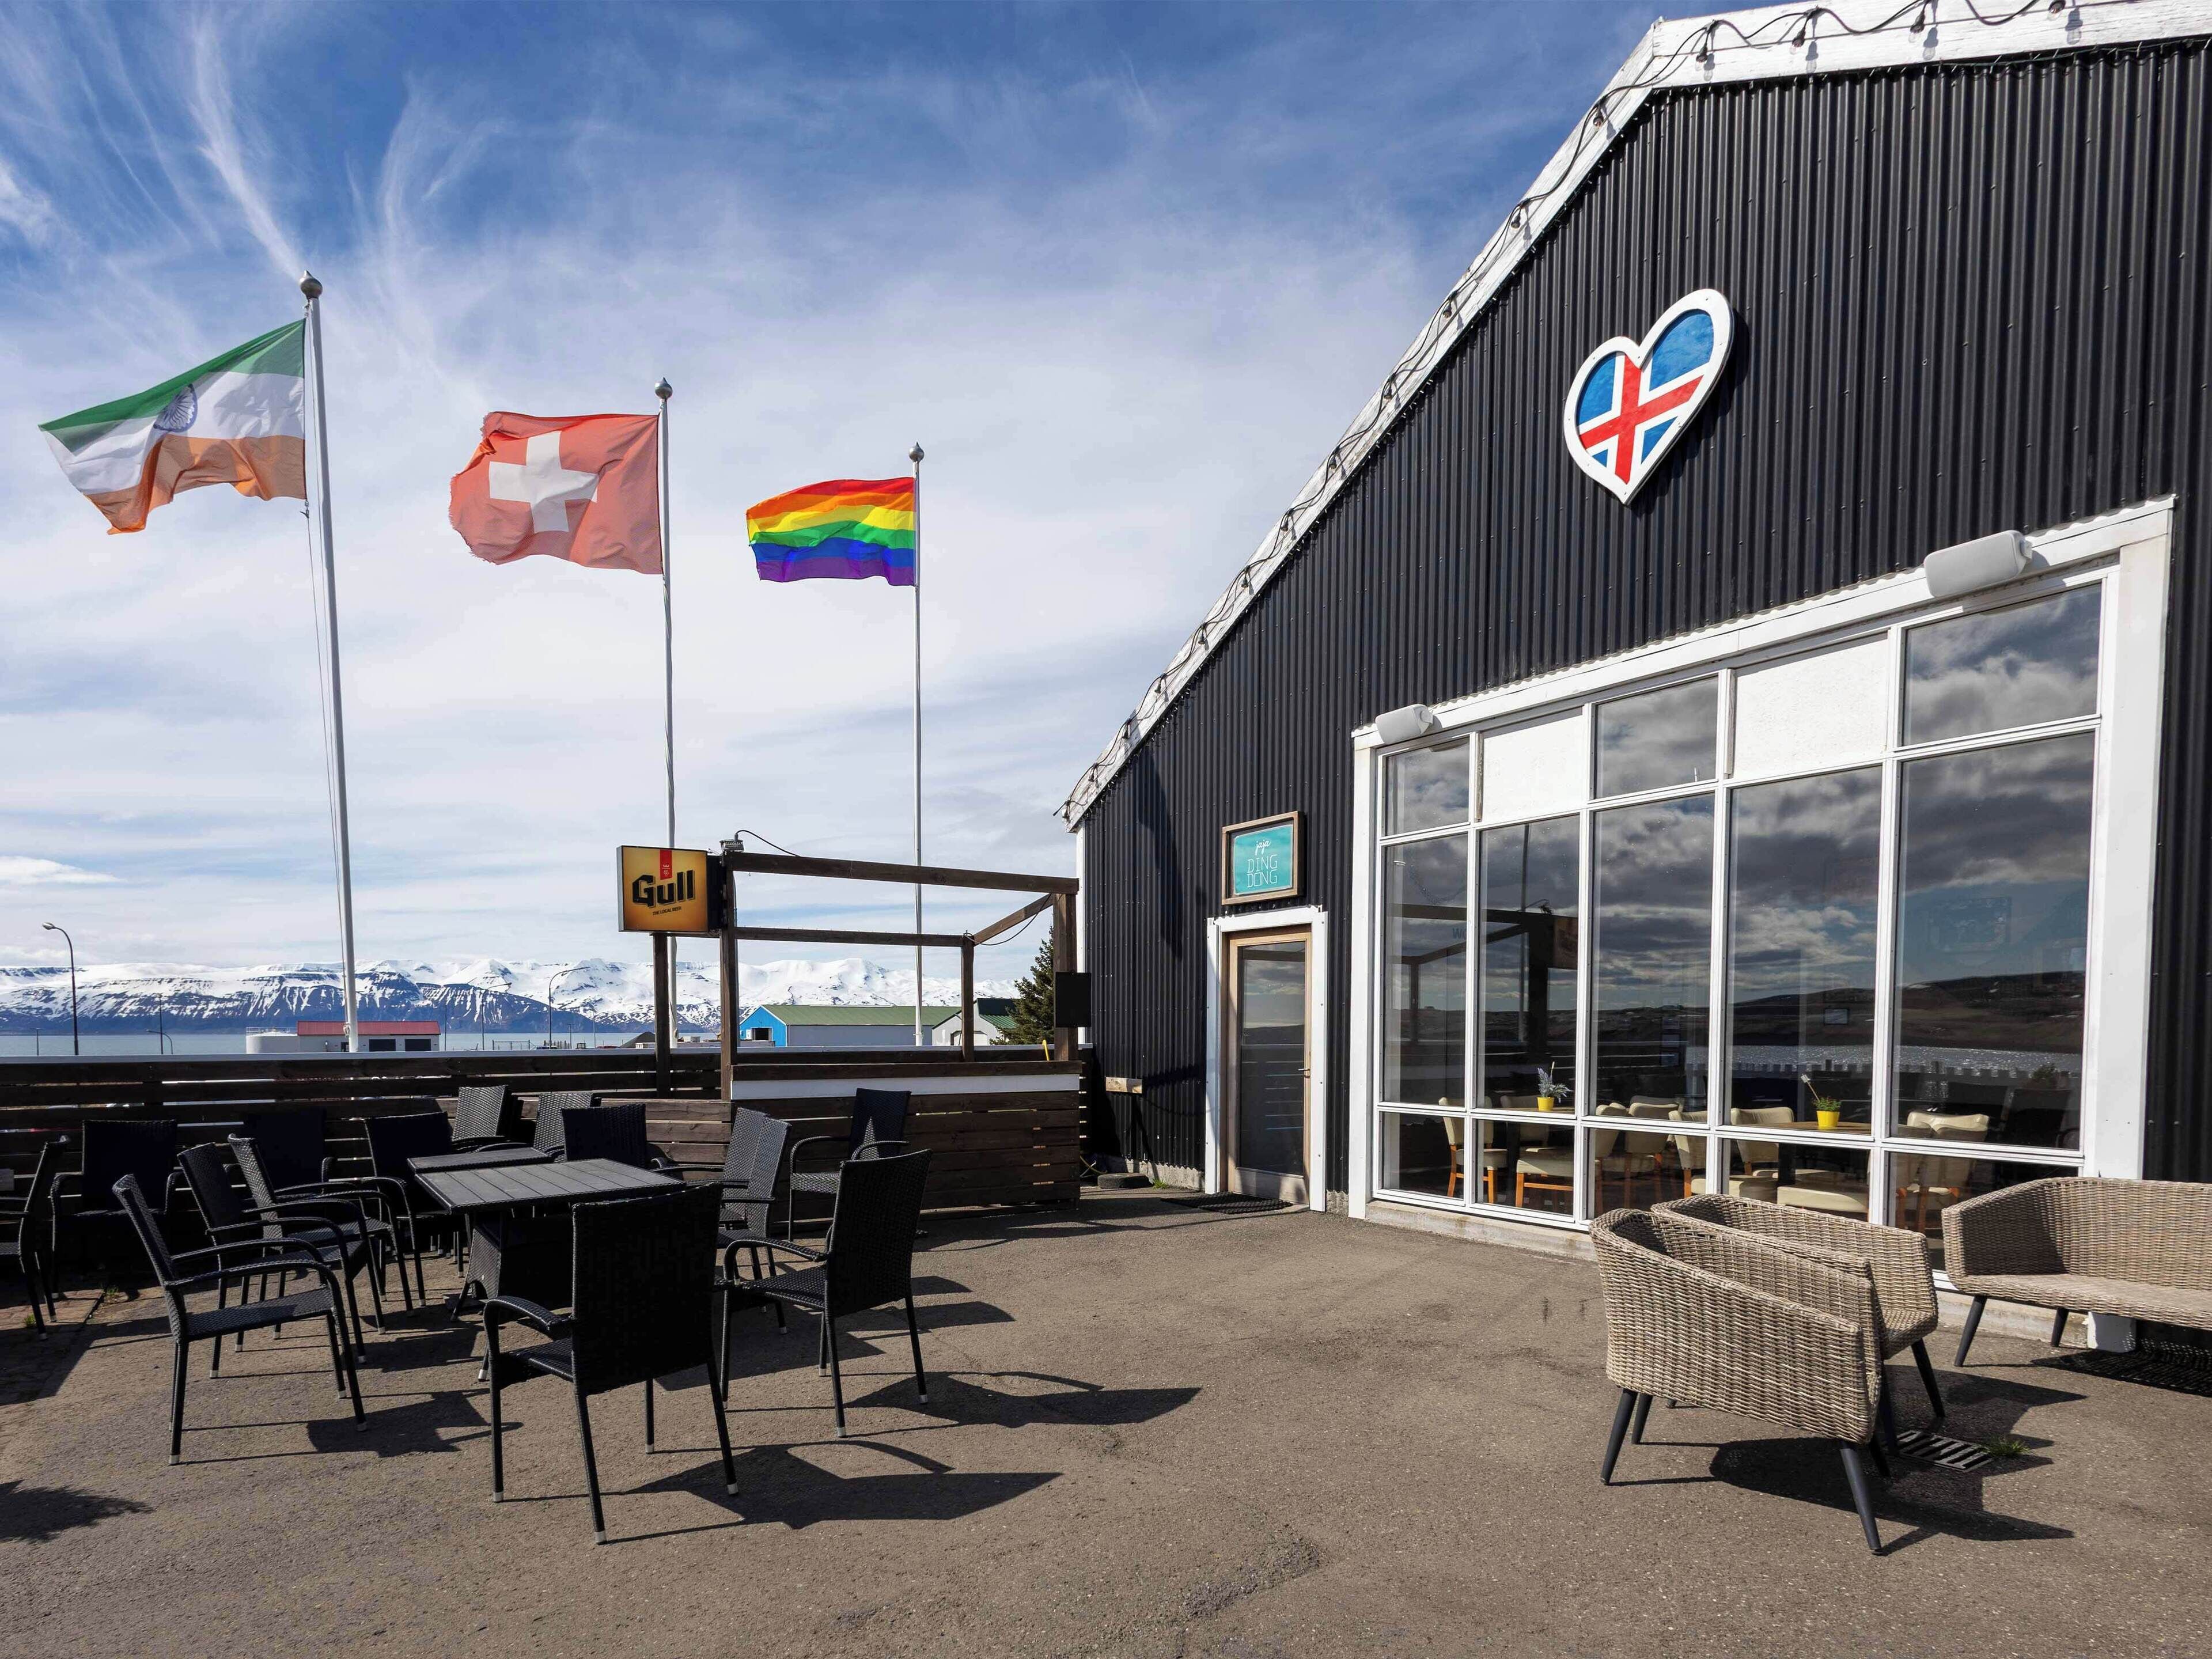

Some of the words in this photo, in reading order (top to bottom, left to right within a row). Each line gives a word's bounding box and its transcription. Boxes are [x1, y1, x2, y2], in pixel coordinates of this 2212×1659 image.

[1247, 854, 1278, 873] DING
[1247, 869, 1278, 888] DONG
[632, 870, 695, 908] Gull
